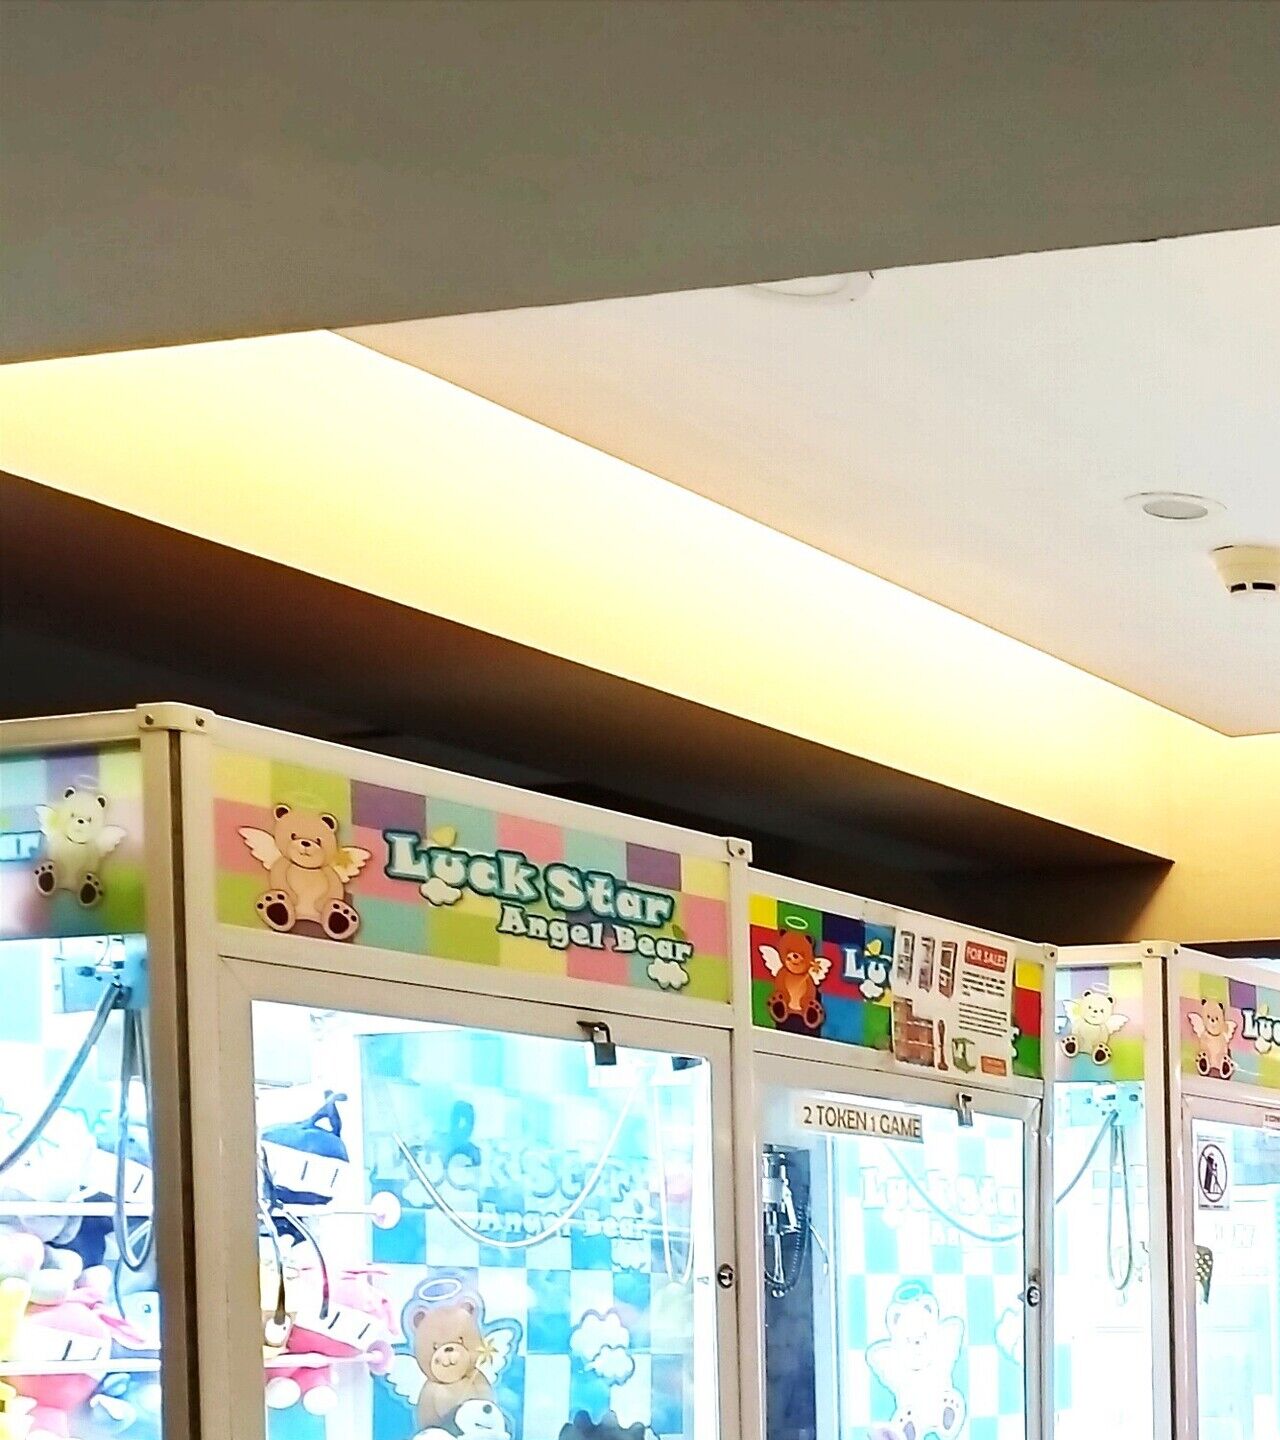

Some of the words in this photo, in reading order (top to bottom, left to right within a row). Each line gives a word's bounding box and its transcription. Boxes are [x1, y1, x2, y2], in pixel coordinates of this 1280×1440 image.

[384, 829, 540, 901] Luck
[543, 863, 675, 928] Star
[496, 903, 604, 950] Angel
[612, 924, 694, 963] Bear
[843, 945, 893, 986] Lu
[803, 1106, 812, 1124] 2
[816, 1105, 866, 1131] TOKEN
[880, 1114, 921, 1138] GAME
